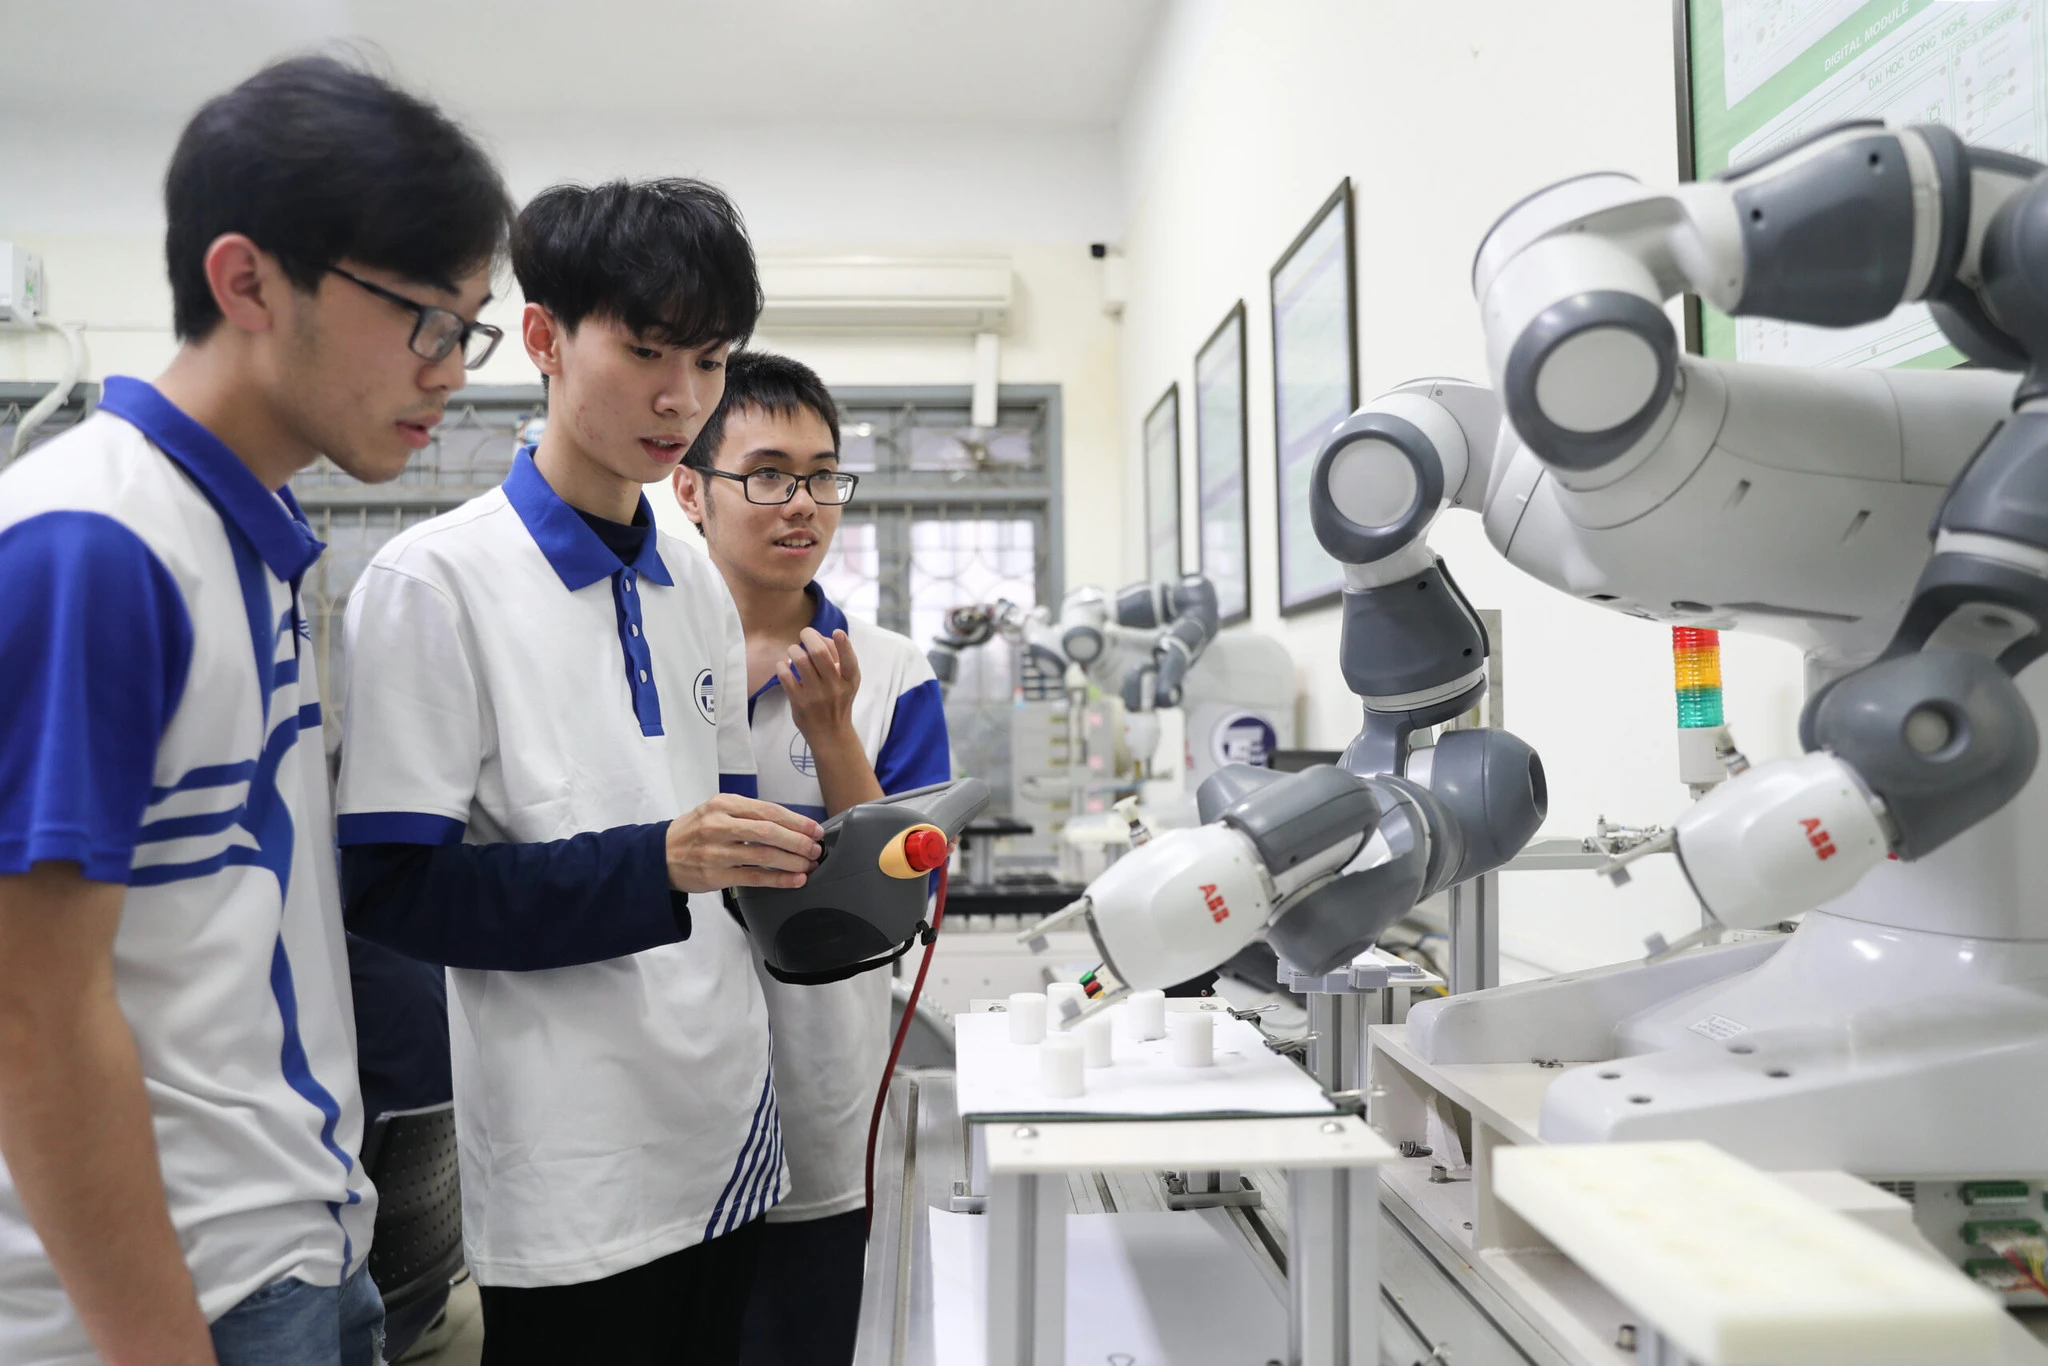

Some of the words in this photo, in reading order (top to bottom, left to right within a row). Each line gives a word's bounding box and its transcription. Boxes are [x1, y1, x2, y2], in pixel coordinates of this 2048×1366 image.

[1824, 36, 1862, 72] DIGITAL
[1864, 0, 1909, 43] MODULE
[1868, 71, 1883, 91] DAI
[1885, 57, 1904, 79] HOC
[1909, 35, 1937, 62] CONG
[1798, 818, 1837, 861] ABB
[1198, 884, 1230, 924] ABB
